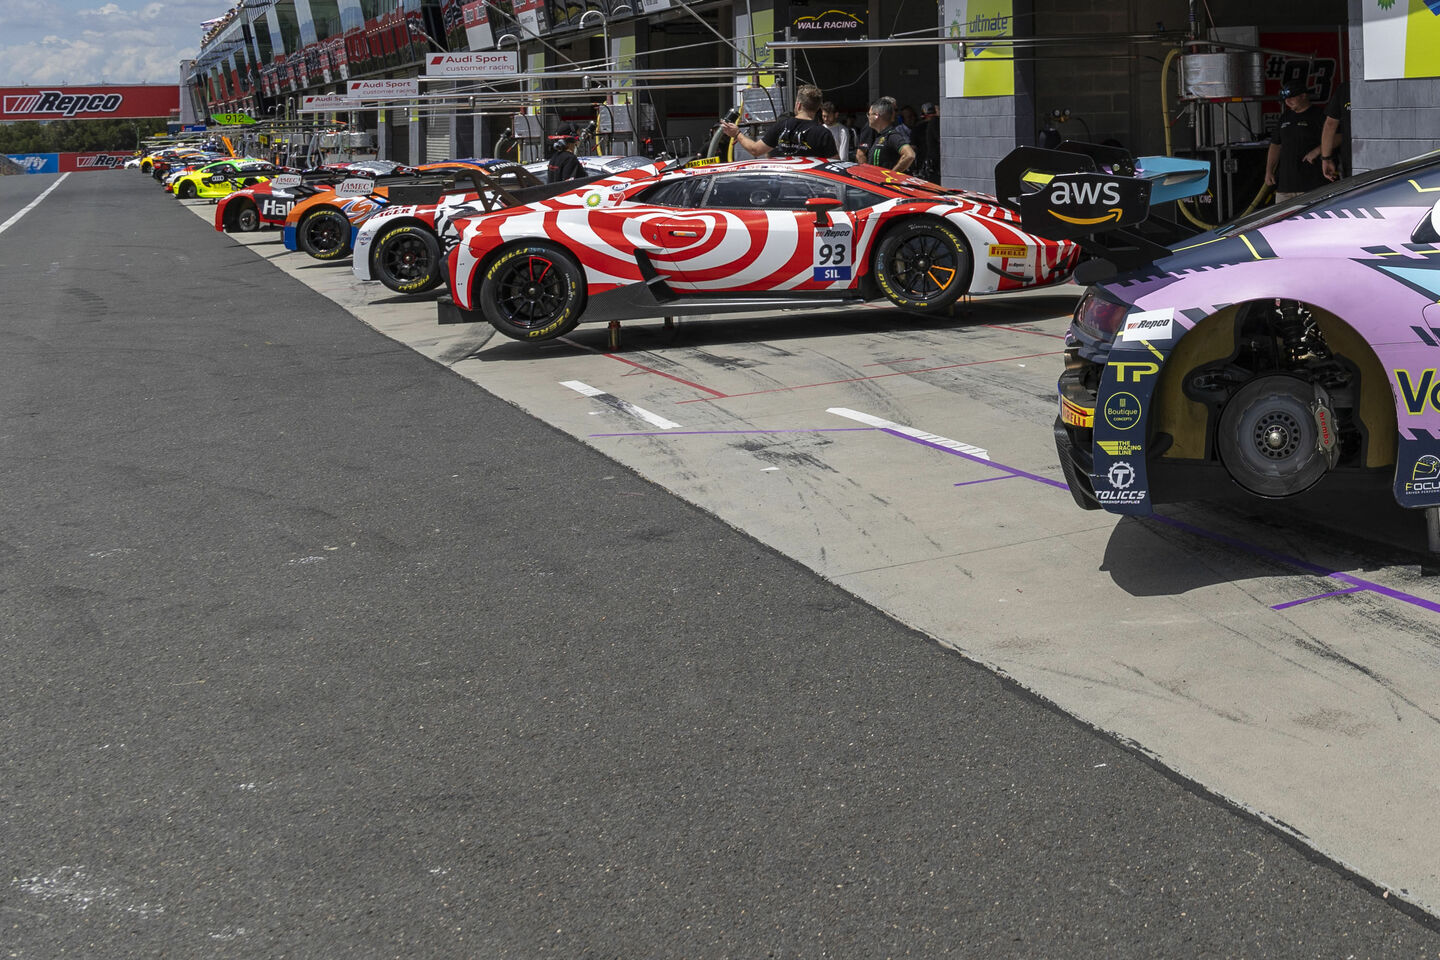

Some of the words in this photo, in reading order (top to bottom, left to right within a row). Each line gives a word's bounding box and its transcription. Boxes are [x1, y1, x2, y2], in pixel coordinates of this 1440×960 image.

[824, 21, 857, 29] RACING
[969, 11, 1008, 33] ultimate
[446, 55, 473, 64] Audi
[475, 54, 507, 65] Sport
[488, 64, 515, 73] racing
[386, 81, 411, 89] Sport
[32, 91, 123, 116] Repco
[225, 114, 245, 123] 912
[1051, 180, 1121, 205] aws
[824, 229, 850, 238] Repco
[819, 244, 846, 266] 93
[488, 248, 529, 280] PIRELLI
[824, 269, 841, 279] SIL
[1137, 318, 1170, 330] Repco
[1107, 361, 1160, 383] TP
[1107, 407, 1138, 417] Boutique
[1094, 490, 1146, 500] TOLICCS
